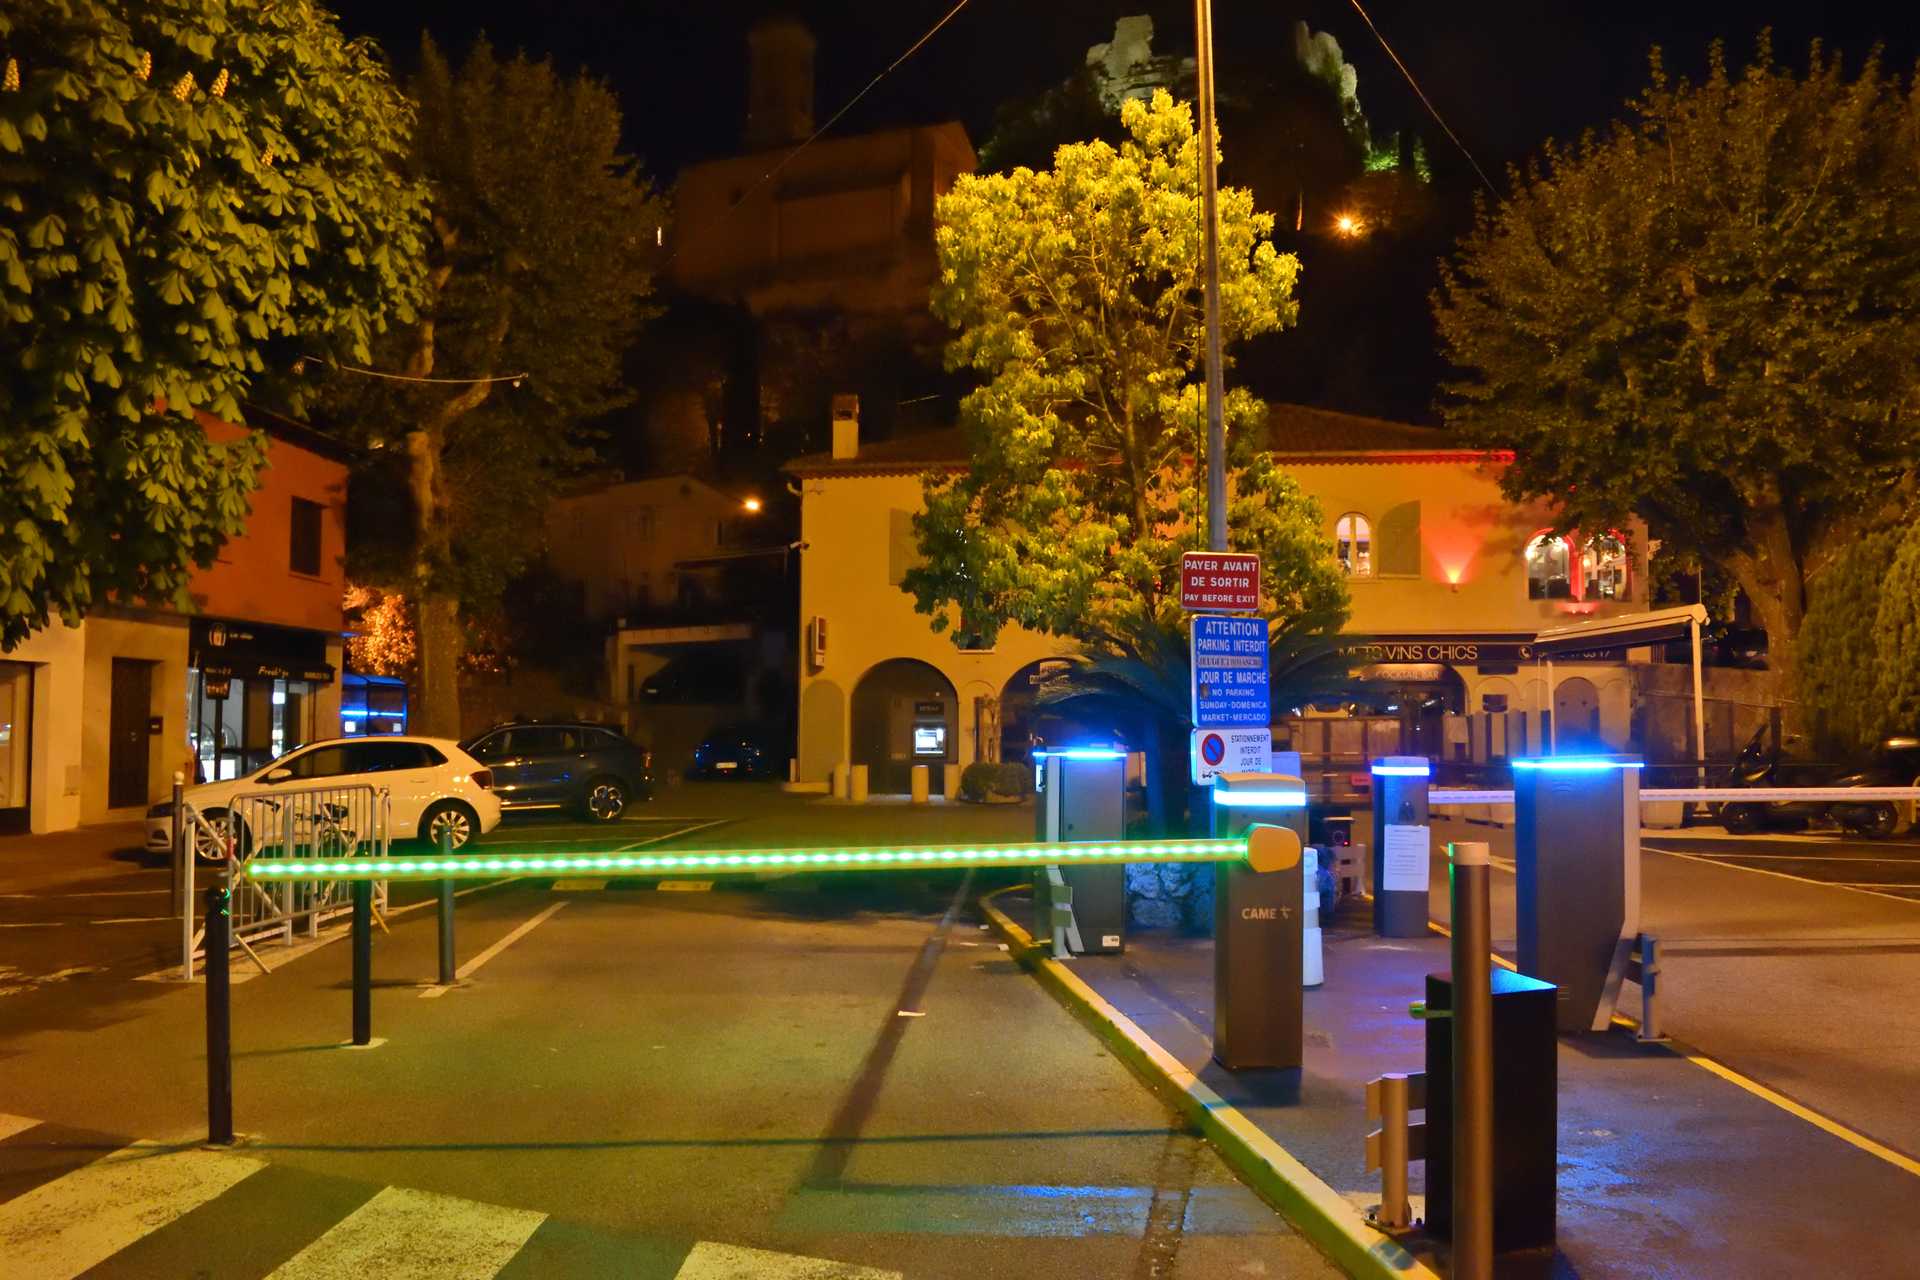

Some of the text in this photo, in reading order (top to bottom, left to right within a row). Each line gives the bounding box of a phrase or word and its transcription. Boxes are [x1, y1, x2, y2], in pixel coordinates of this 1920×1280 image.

[1184, 559, 1257, 572] PAYER AVANT
[1191, 576, 1250, 588] DE SORTIR
[1202, 594, 1233, 603] BEFORE
[1236, 595, 1256, 603] EXIT
[1205, 621, 1259, 636] ATTENTION
[1198, 638, 1266, 653] PARKING INTERDIT
[1385, 645, 1423, 660] VINS
[1427, 645, 1478, 661] CHICS
[1199, 671, 1267, 685] JOUR DE MARCHE
[1211, 688, 1255, 697] NO PARKING
[1241, 907, 1277, 920] CAME
